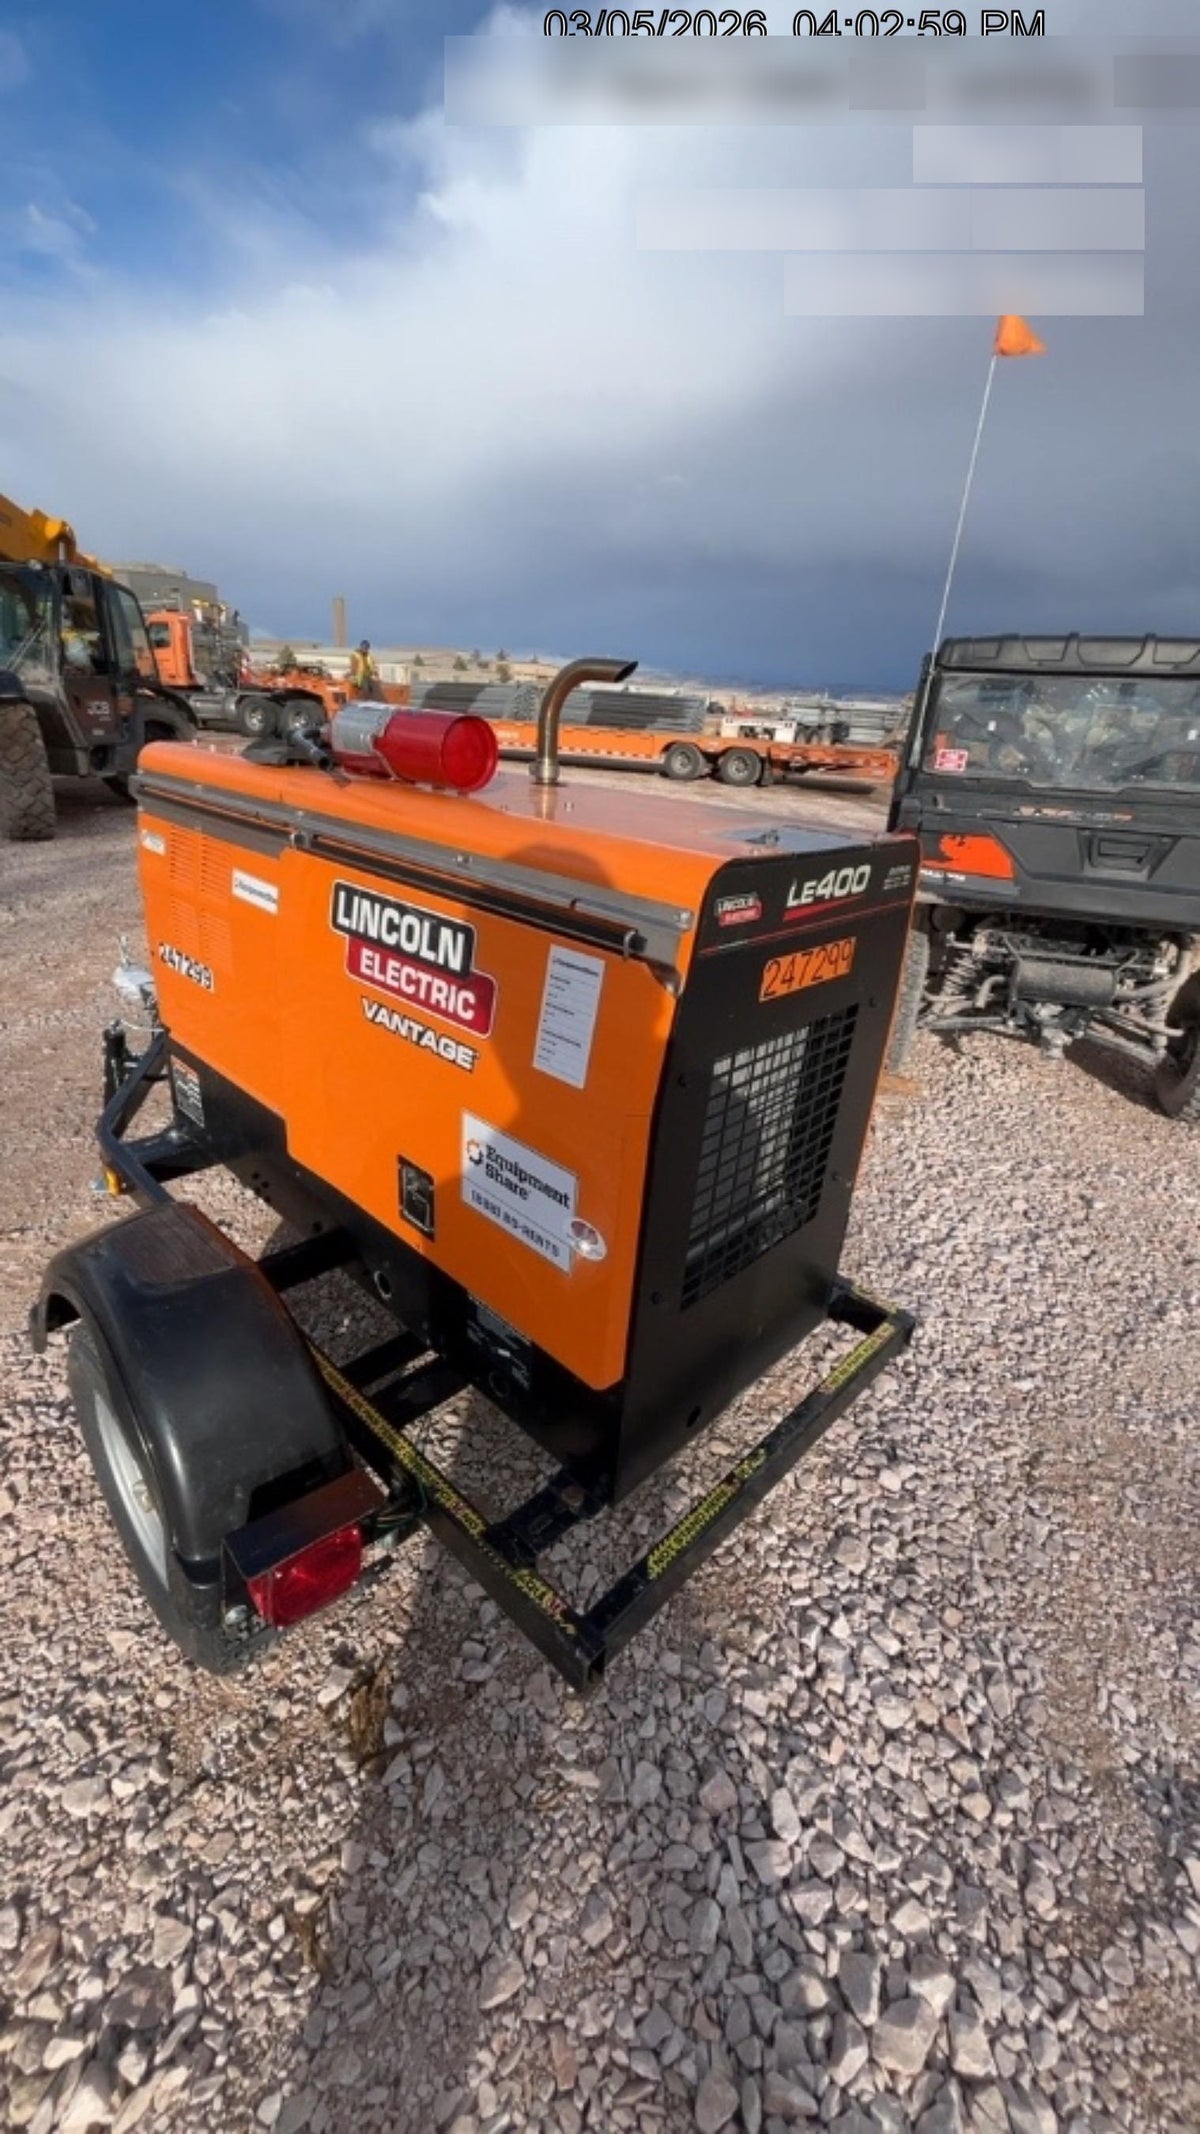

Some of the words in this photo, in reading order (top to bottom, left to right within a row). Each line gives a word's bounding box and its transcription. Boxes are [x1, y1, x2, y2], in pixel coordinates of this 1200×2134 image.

[786, 865, 871, 908] LE400
[336, 890, 466, 973] LINCOLN
[359, 946, 476, 1021] ELECTRIC
[763, 941, 852, 997] 247299
[361, 996, 477, 1073] VANTAGE
[485, 1144, 571, 1210] Equipment
[485, 1162, 529, 1201] Share
